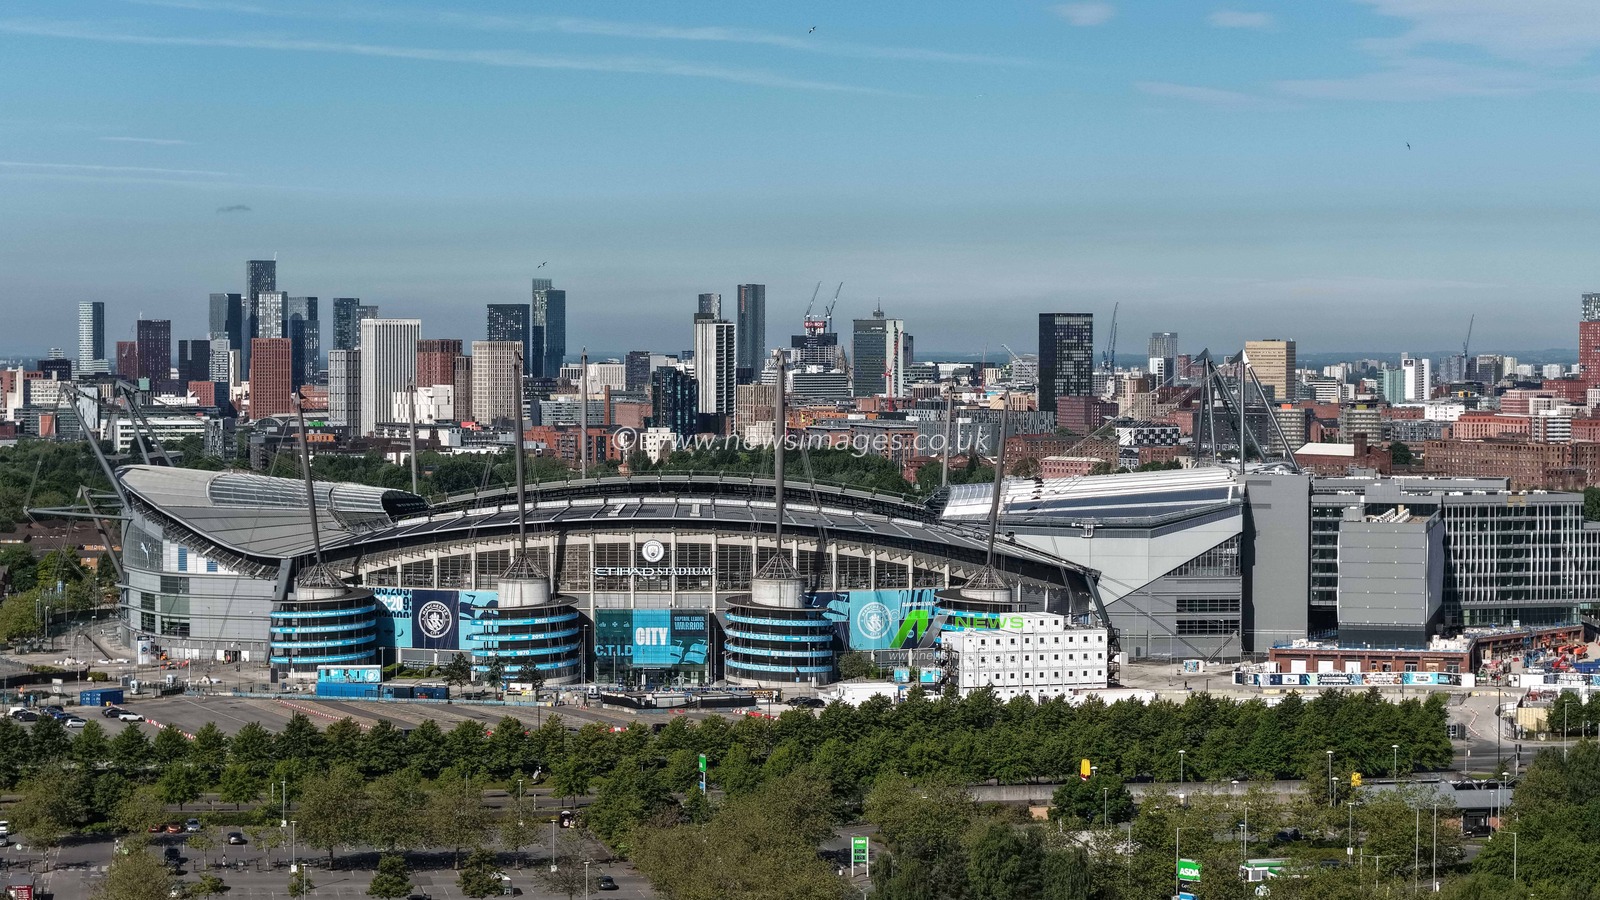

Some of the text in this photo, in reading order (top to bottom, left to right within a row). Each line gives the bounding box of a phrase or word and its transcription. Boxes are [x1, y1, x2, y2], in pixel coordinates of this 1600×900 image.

[594, 567, 711, 576] ETIHAD STADIUM
[674, 621, 705, 630] WARRIOR
[635, 627, 669, 646] CITY
[1179, 867, 1200, 877] ASDA
